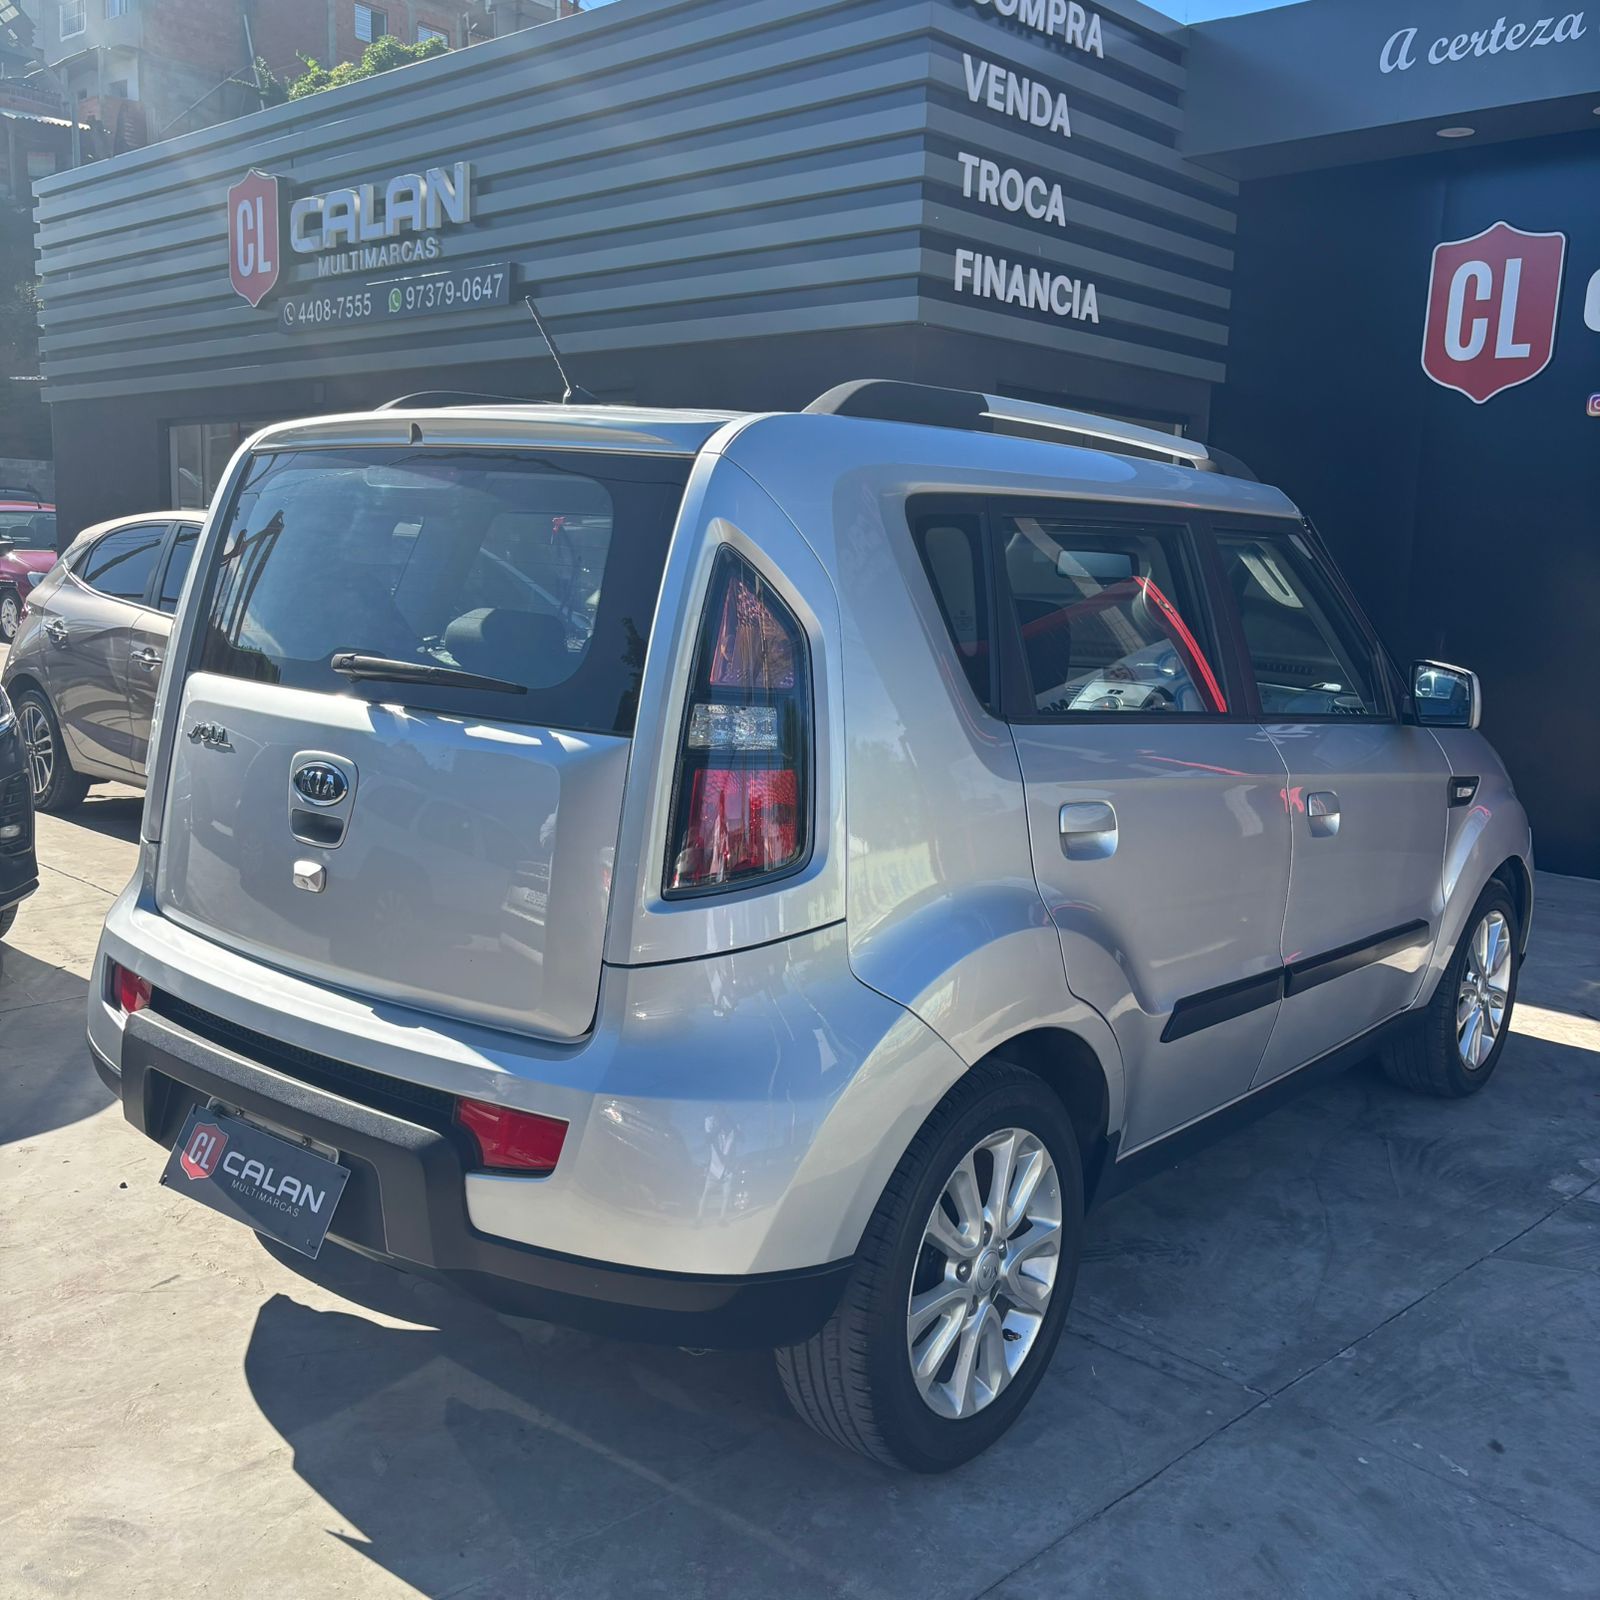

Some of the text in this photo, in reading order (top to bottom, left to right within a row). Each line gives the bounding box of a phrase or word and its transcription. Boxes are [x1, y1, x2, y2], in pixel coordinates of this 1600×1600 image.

[974, 0, 1105, 59] MPRA
[1379, 11, 1587, 74] A certeza
[962, 52, 1072, 138] VENDA
[290, 161, 470, 253] CALAN
[957, 151, 1066, 228] TROCA
[236, 196, 272, 276] CL
[317, 236, 441, 277] MULTIMARCAS
[298, 273, 504, 325] 4408-7555 97379-0647
[954, 248, 1100, 324] FINANCIA
[1444, 257, 1531, 362] CL
[301, 769, 337, 798] KIA
[189, 1132, 216, 1170] CL
[222, 1151, 326, 1214] CALAN
[231, 1179, 300, 1217] MULTIMARCAS
